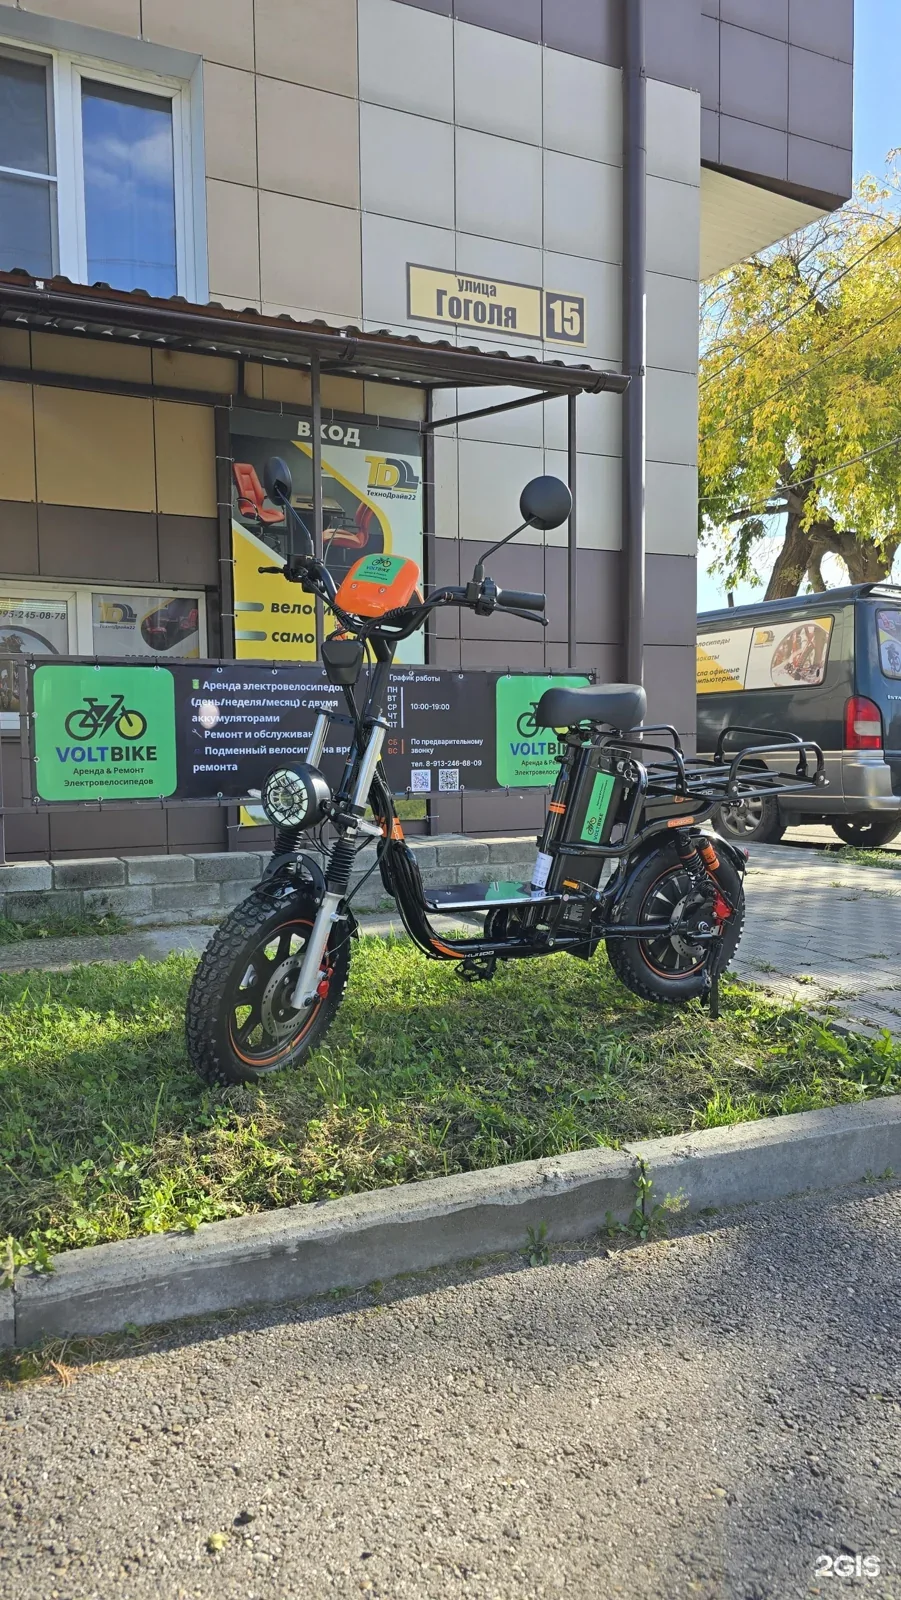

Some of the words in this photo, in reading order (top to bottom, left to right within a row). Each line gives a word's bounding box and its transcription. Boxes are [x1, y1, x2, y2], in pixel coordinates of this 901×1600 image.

[457, 278, 497, 298] улица
[436, 288, 517, 329] Гоголя
[550, 300, 581, 336] 15
[366, 489, 417, 501] ТехноДрайв22
[709, 667, 740, 676] офисные
[389, 674, 414, 682] График
[696, 675, 740, 684] мпьютерные
[202, 681, 241, 691] Аренда
[191, 698, 300, 708] (день/неделя/месяц)
[308, 700, 339, 708] двумя
[191, 715, 280, 724] аккумуляторами
[204, 731, 243, 739] Ремонт
[253, 731, 313, 740] обслуживан
[421, 739, 483, 747] предварительному
[55, 746, 157, 763] VOLTBIKE
[204, 746, 267, 756] Подменный
[336, 747, 351, 755] вре
[73, 767, 104, 776] Аренда
[113, 766, 144, 774] Ремонт
[192, 763, 238, 772] ремонта
[64, 778, 154, 788] Электровелосипедов
